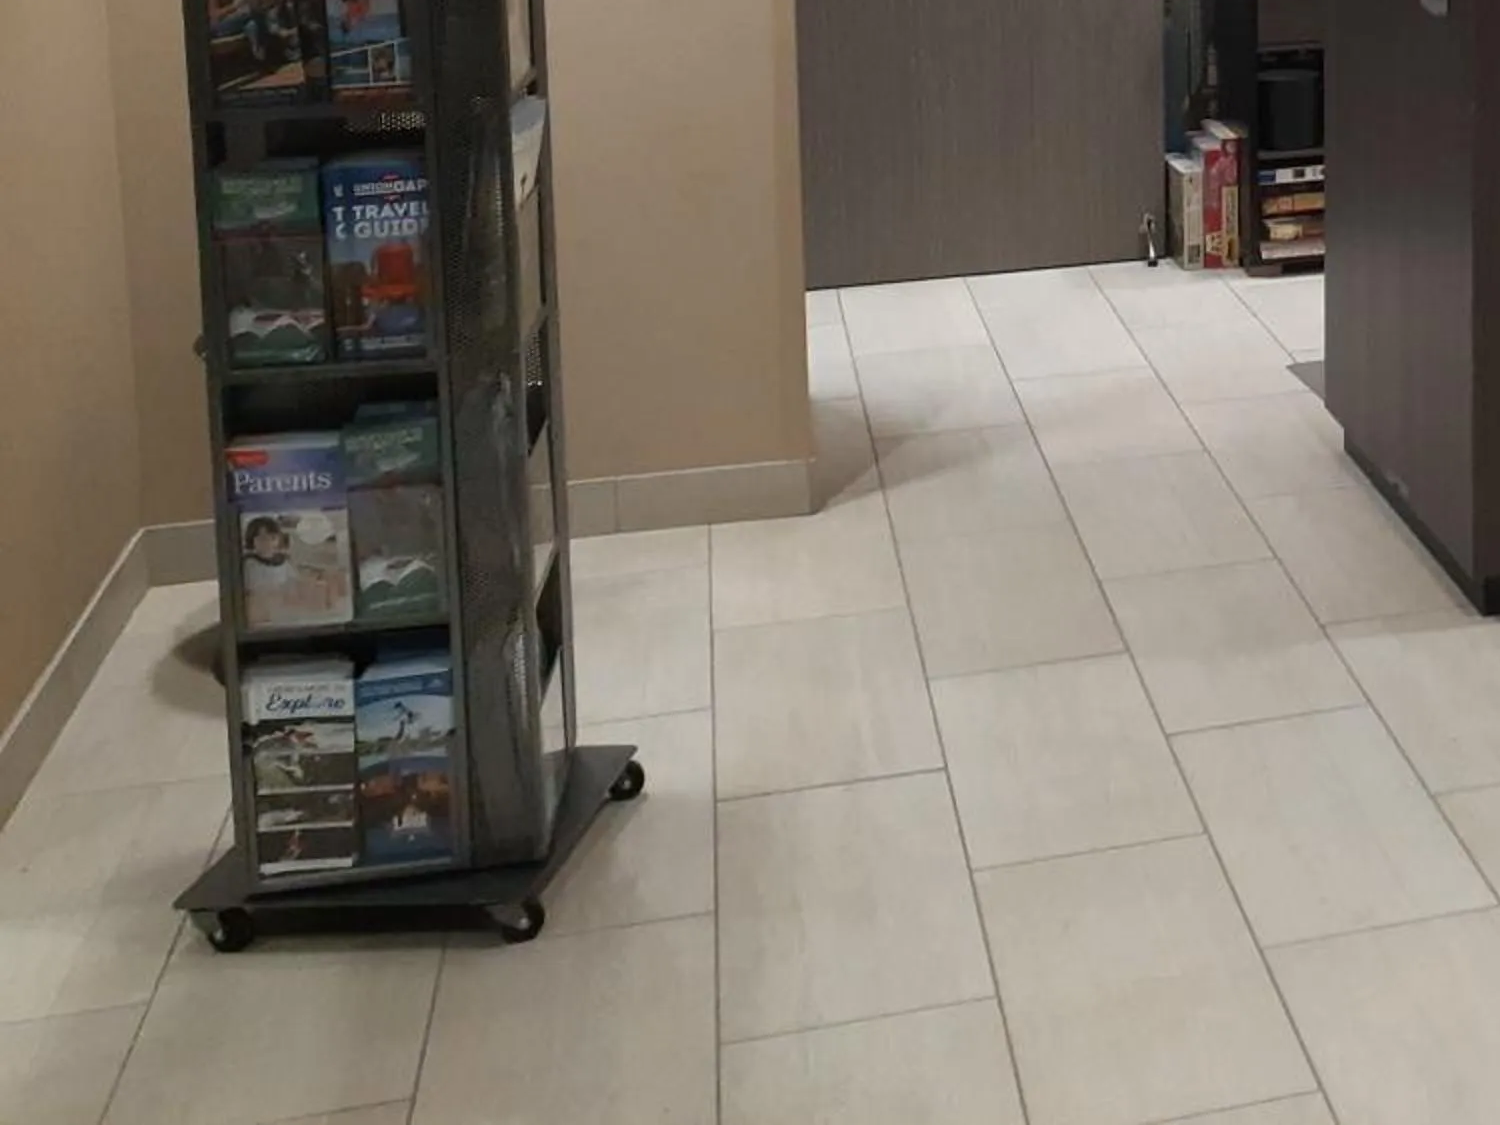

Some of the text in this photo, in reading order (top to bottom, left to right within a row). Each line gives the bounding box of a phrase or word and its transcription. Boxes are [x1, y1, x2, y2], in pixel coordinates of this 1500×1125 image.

[394, 177, 429, 193] GAP
[351, 200, 430, 221] TRAVEL
[233, 470, 333, 495] Parents
